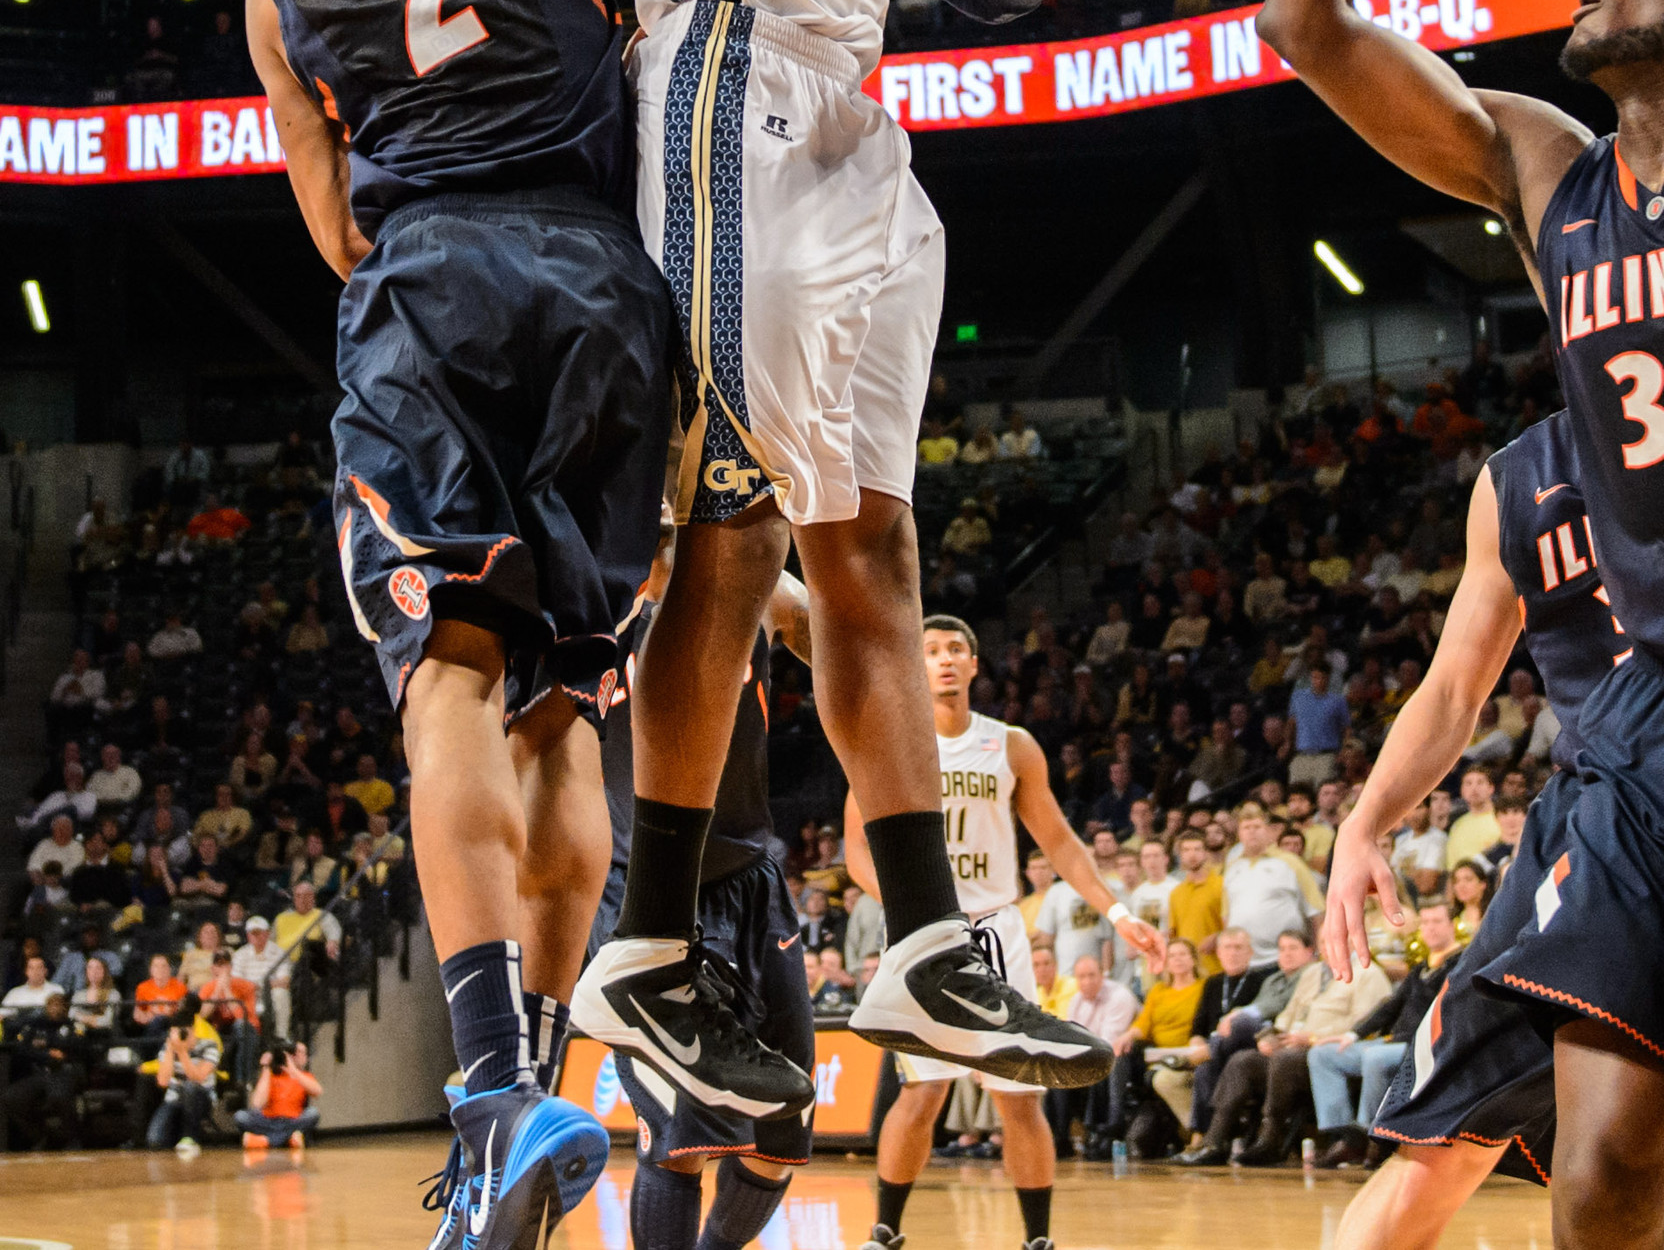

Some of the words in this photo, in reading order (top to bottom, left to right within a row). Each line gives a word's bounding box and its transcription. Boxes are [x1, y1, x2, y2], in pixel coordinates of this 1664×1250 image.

[880, 55, 1033, 123] FIRST
[1053, 29, 1195, 112] NAME
[1208, 15, 1263, 84] IN
[126, 112, 180, 172] IN
[703, 458, 761, 496] GT
[941, 770, 998, 802] ORGIA
